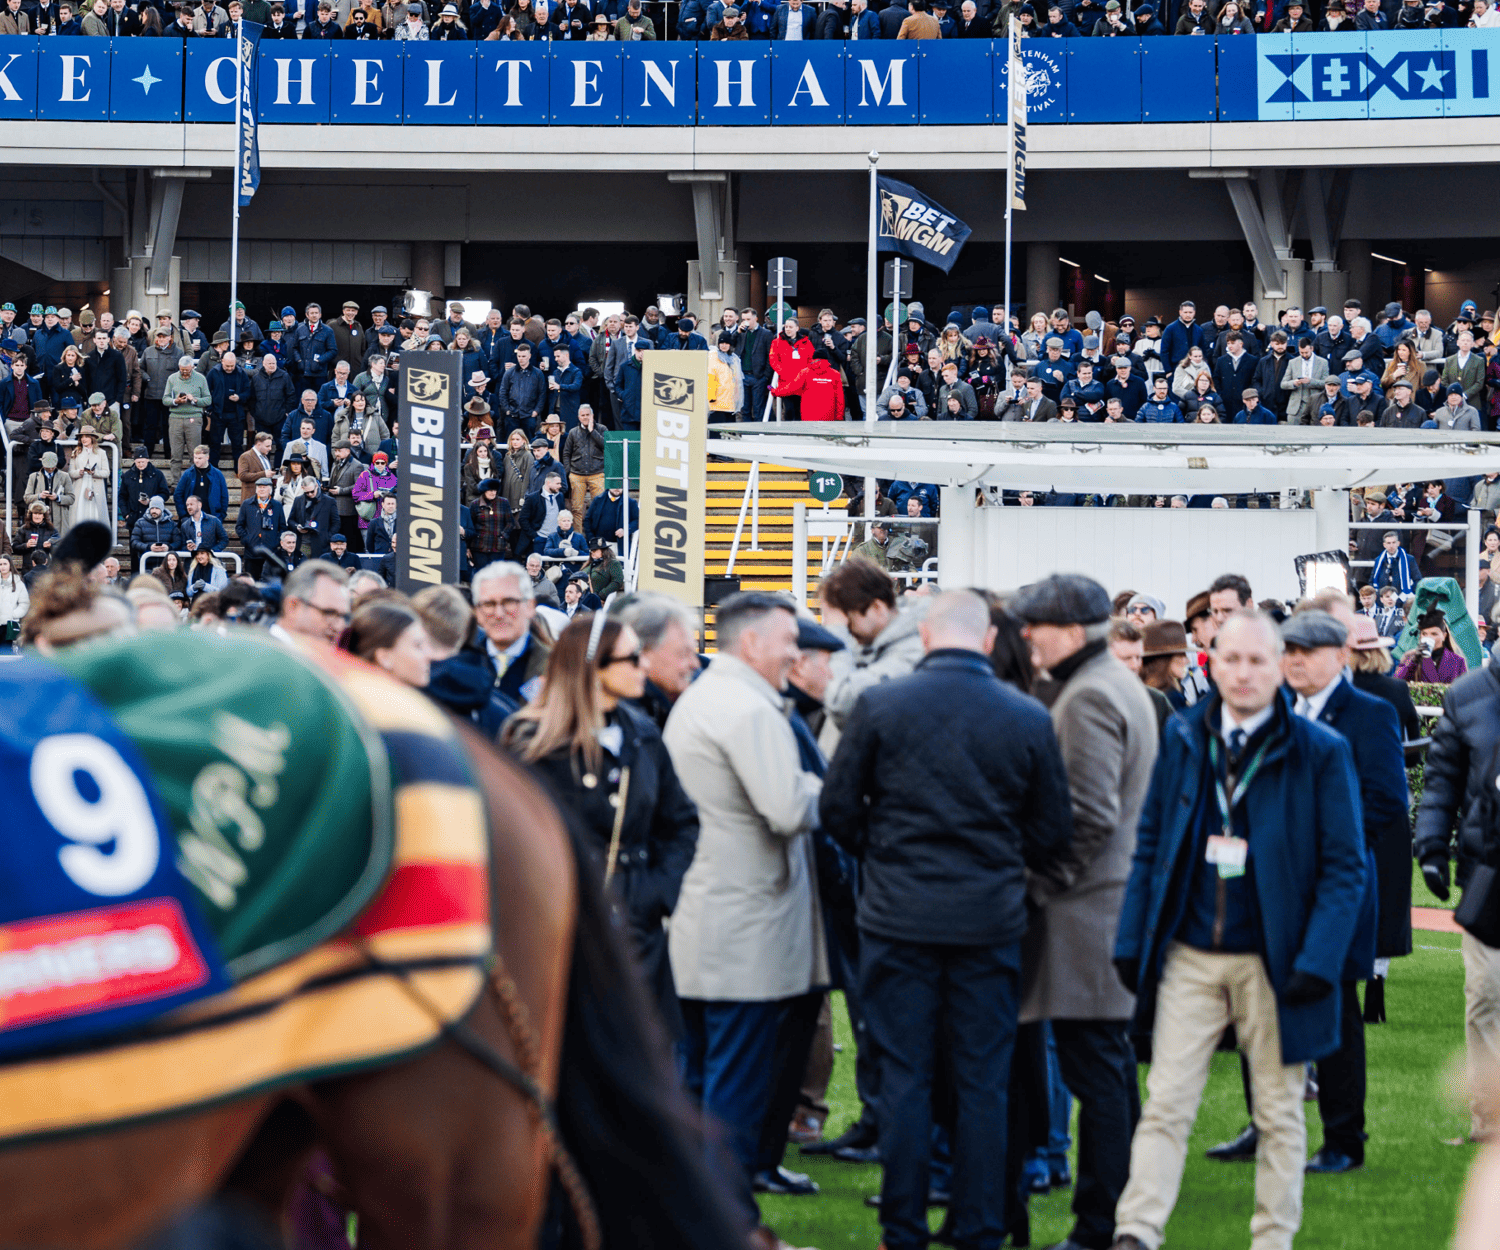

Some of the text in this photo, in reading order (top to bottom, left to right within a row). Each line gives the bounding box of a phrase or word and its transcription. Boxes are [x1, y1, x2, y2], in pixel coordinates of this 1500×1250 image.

[204, 56, 908, 107] CHELTENHAM
[1001, 50, 1060, 75] CHTENHAM
[1013, 60, 1028, 200] BETMGM
[896, 217, 956, 256] MGM
[902, 201, 957, 233] BET
[409, 405, 446, 585] BETMGM
[654, 409, 690, 583] BETMGM
[816, 477, 836, 494] 1st
[30, 733, 160, 897] 9
